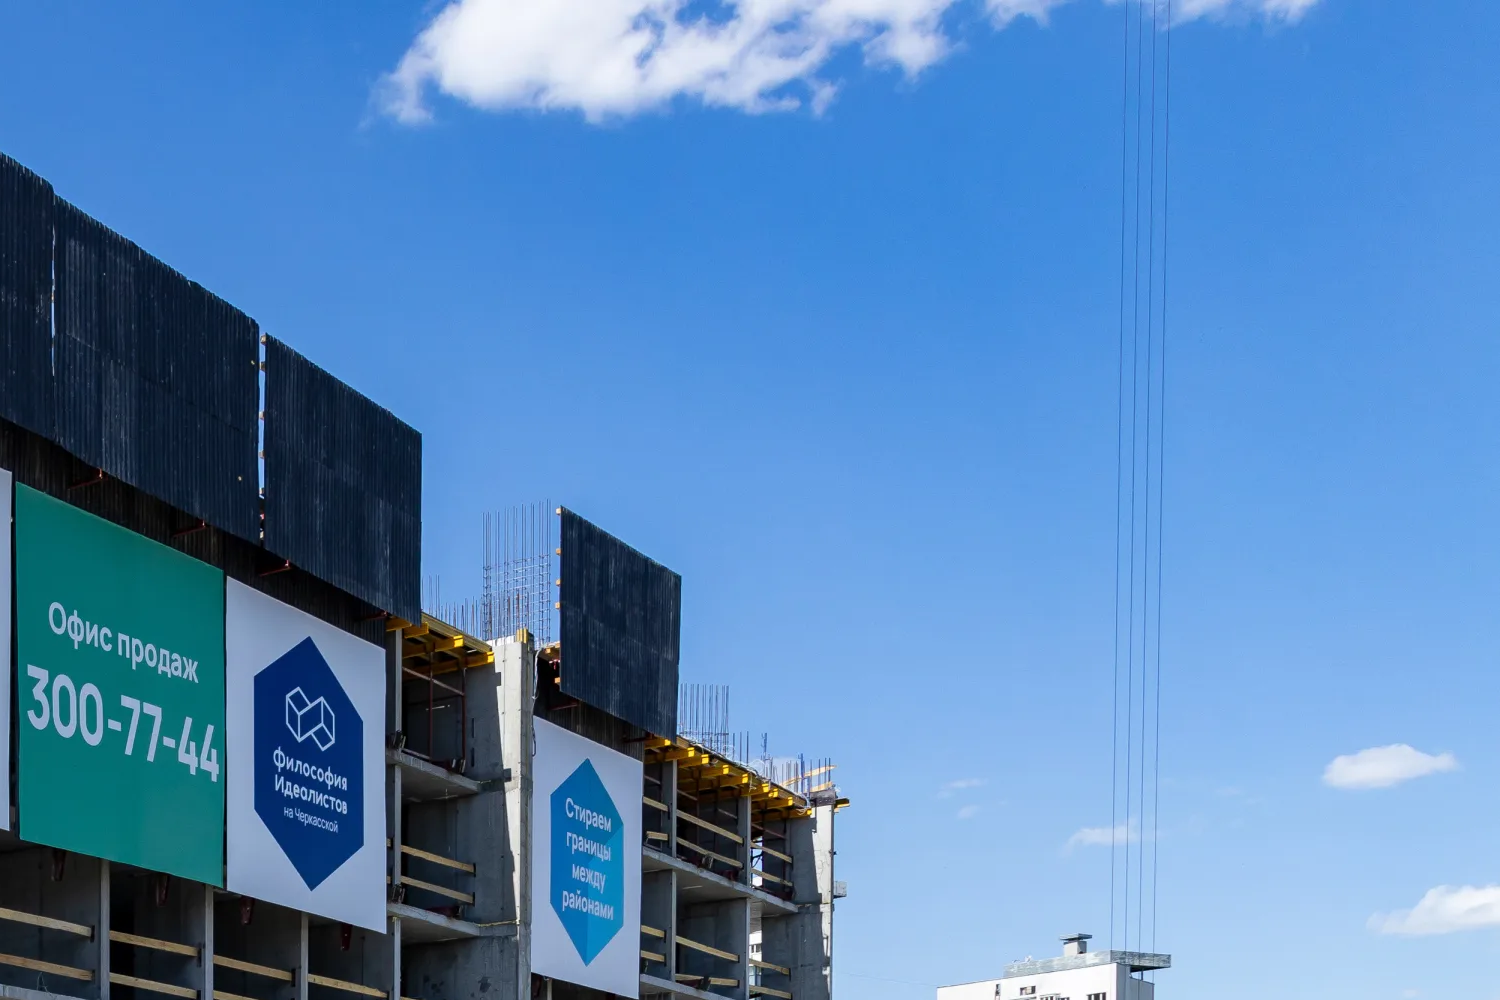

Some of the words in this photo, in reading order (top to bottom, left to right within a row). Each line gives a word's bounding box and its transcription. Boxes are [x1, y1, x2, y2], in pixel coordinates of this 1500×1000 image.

[48, 601, 113, 652] Офис
[117, 632, 199, 684] продаж
[27, 664, 220, 783] 300-77-44
[273, 746, 348, 791] Философия
[275, 774, 348, 815] Идеалистов
[283, 807, 294, 818] на
[294, 807, 339, 833] Черкасской
[565, 797, 612, 833] Стираем
[566, 831, 611, 862] границы
[572, 863, 607, 894] между
[562, 889, 614, 920] районами
